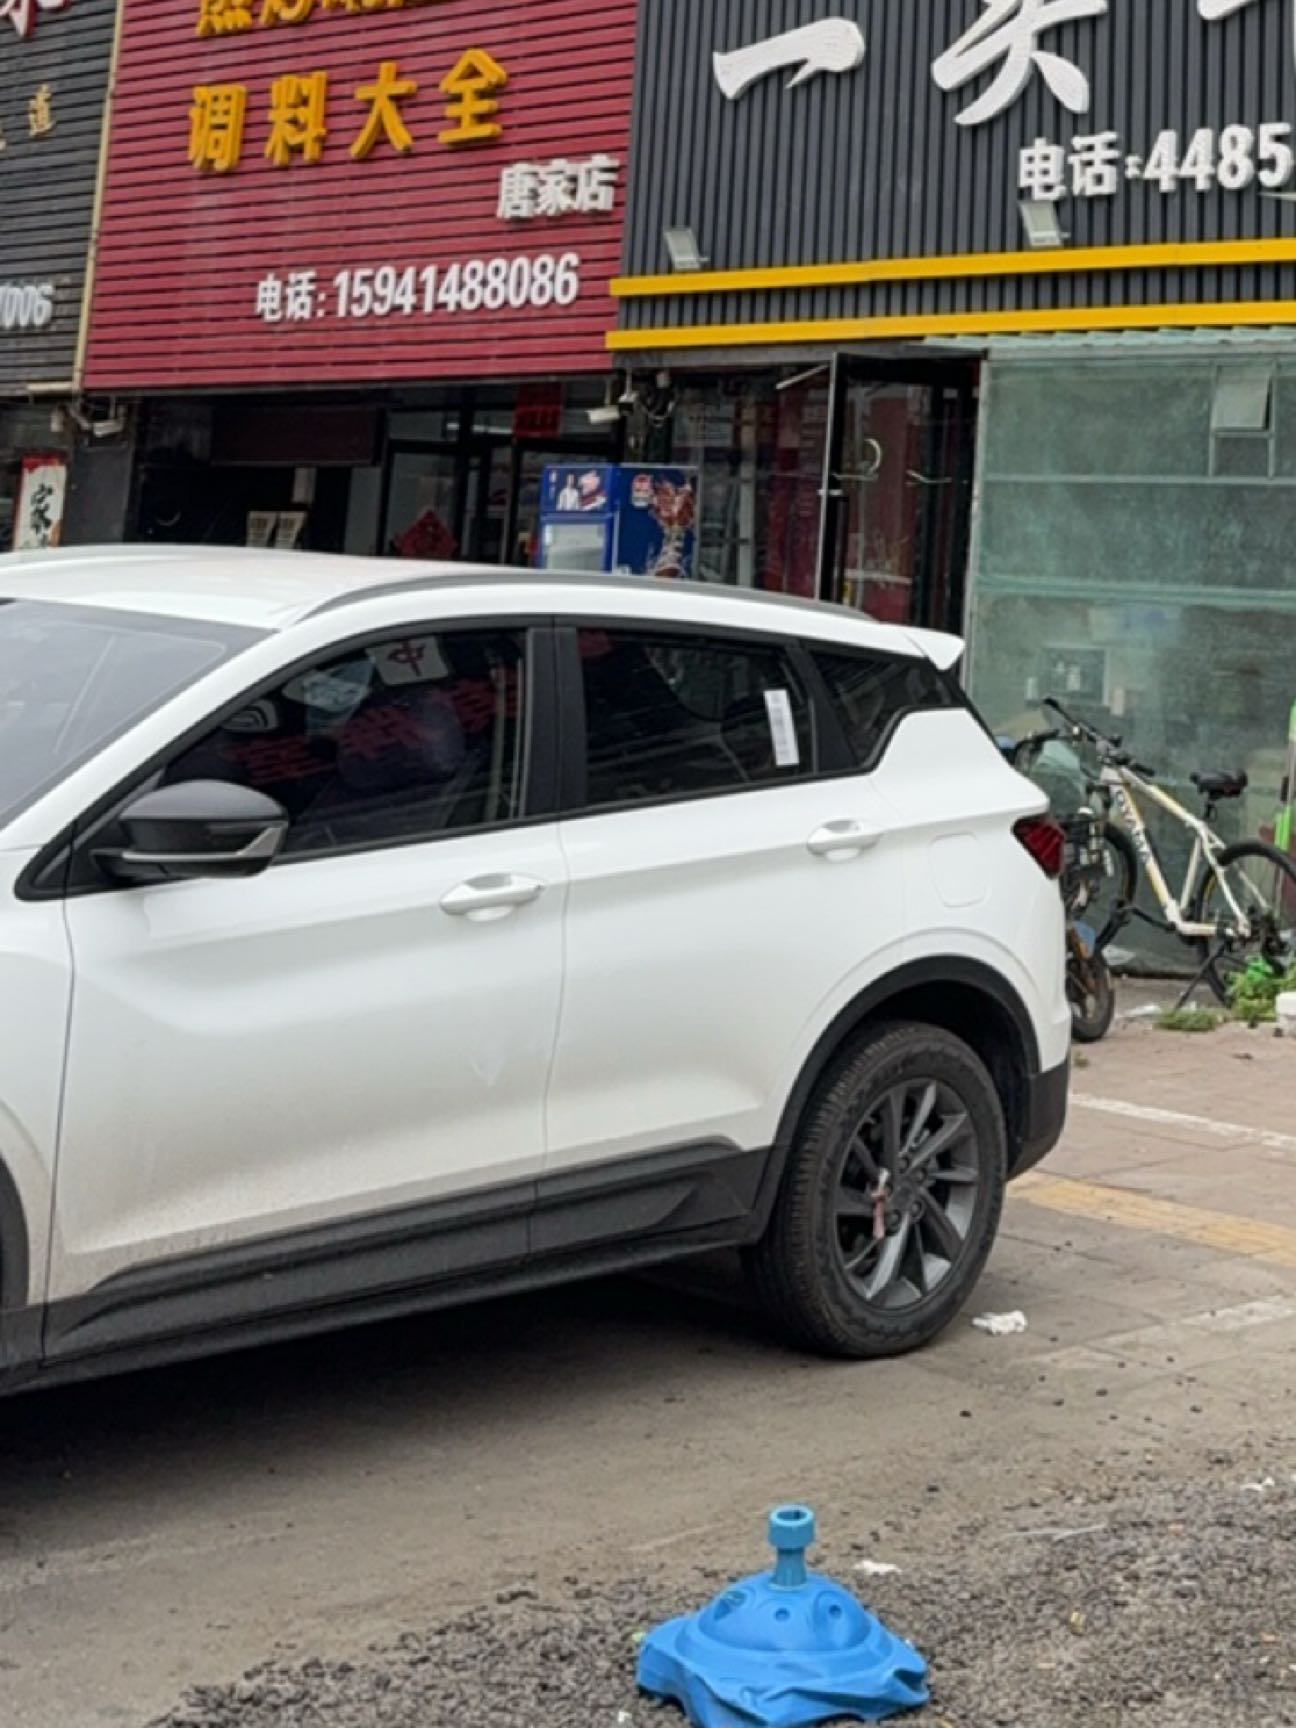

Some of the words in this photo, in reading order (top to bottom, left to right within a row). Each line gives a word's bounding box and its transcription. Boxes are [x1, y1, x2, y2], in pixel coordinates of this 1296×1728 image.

[187, 47, 508, 172] 调料大全
[255, 252, 580, 323] 电话:15941488086
